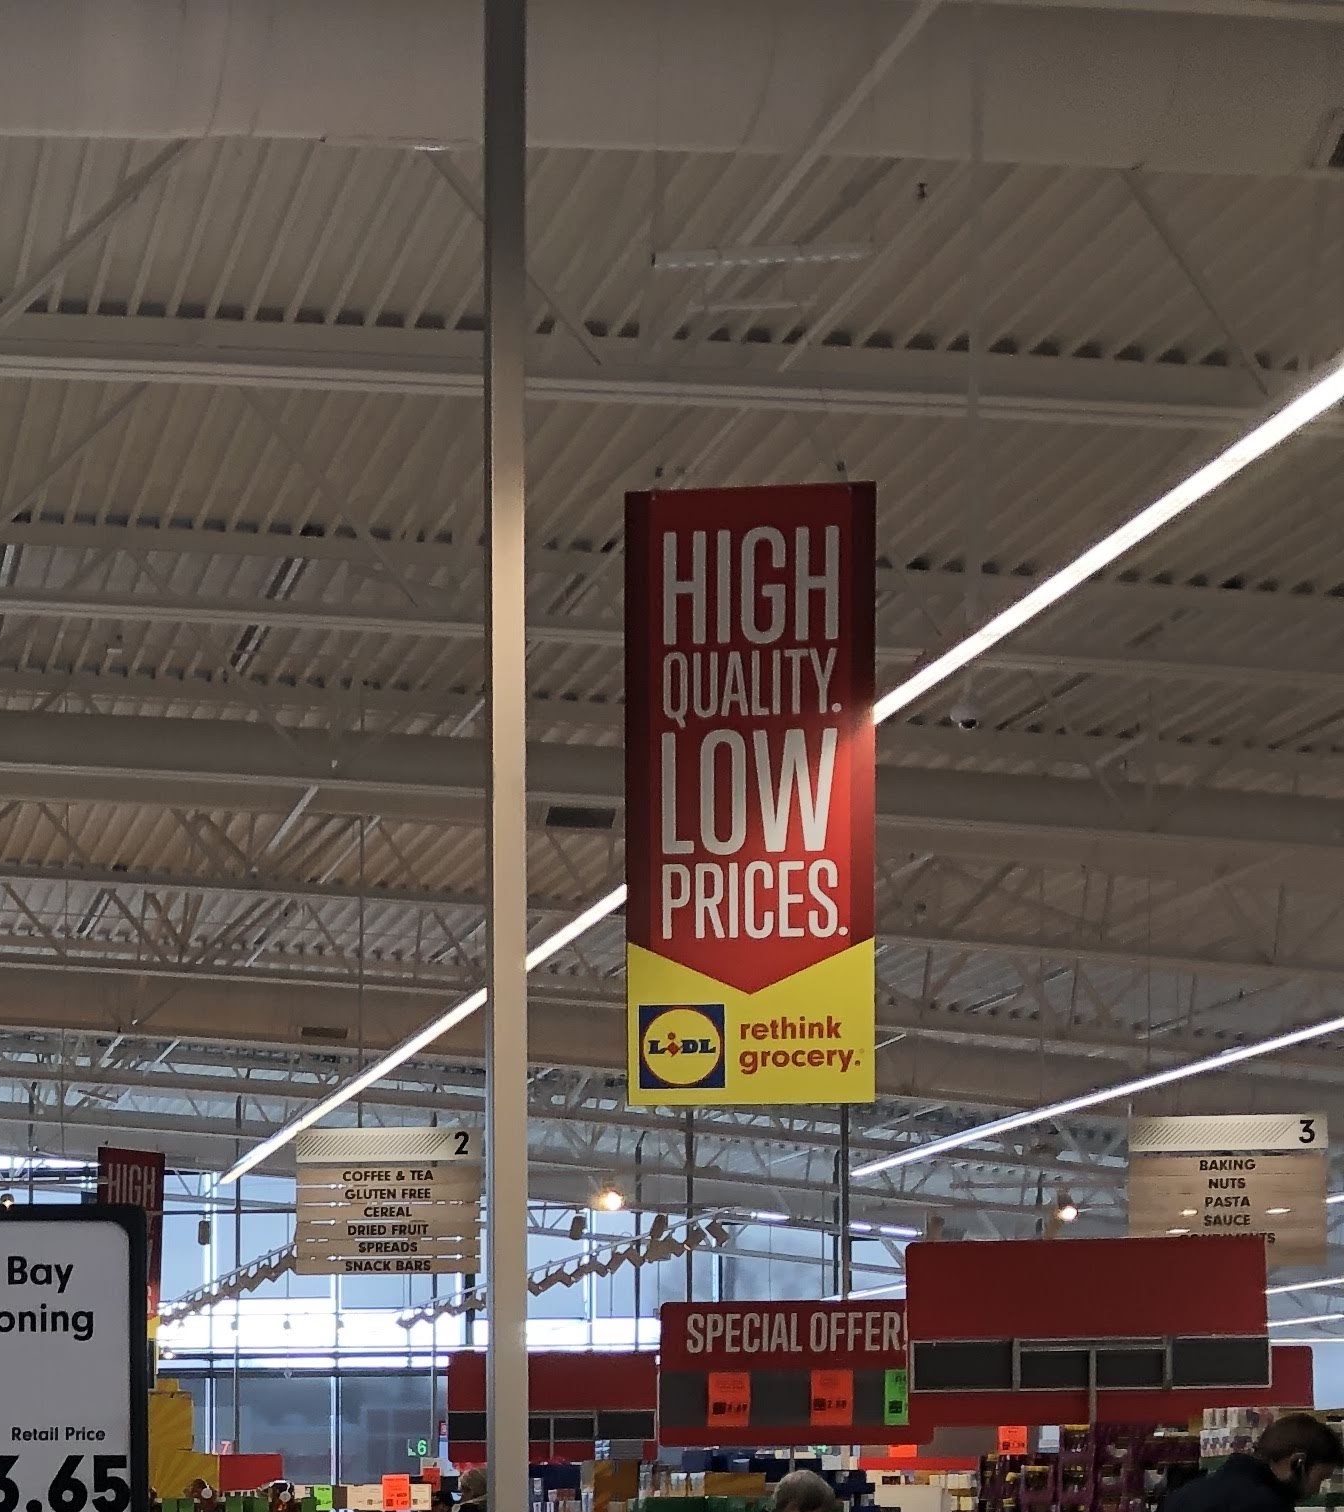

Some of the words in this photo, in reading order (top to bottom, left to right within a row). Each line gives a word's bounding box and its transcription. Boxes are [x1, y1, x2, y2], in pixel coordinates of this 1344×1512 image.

[663, 525, 840, 646] HIGH
[663, 648, 842, 728] QUALITY.
[661, 728, 838, 857] LOW
[662, 859, 849, 940] PRICES.
[740, 1016, 842, 1040] rethink
[739, 1046, 861, 1074] grocery.
[1298, 1119, 1316, 1144] 3
[453, 1131, 470, 1156] 2
[1199, 1158, 1256, 1172] BAKING
[342, 1170, 392, 1182] COFFEE
[395, 1170, 407, 1182] &
[409, 1170, 434, 1182] TEA
[1208, 1177, 1246, 1190] NUTS
[108, 1162, 156, 1208] HIGH
[344, 1188, 397, 1200] GLUTEN
[401, 1188, 432, 1200] FREE
[1204, 1195, 1251, 1209] PASTA
[363, 1206, 413, 1218] CEREAL
[1203, 1213, 1252, 1227] SAUCE
[347, 1224, 388, 1236] DRIED
[391, 1224, 429, 1236] FRUIT
[358, 1241, 418, 1254] SPREADS
[6, 1255, 74, 1293] Bay
[344, 1260, 391, 1272] SNACK
[395, 1260, 432, 1272] BARS
[686, 1312, 803, 1354] SPECIAL
[11, 1426, 59, 1442] Retail
[65, 1426, 106, 1442] Price
[417, 1440, 428, 1456] 6
